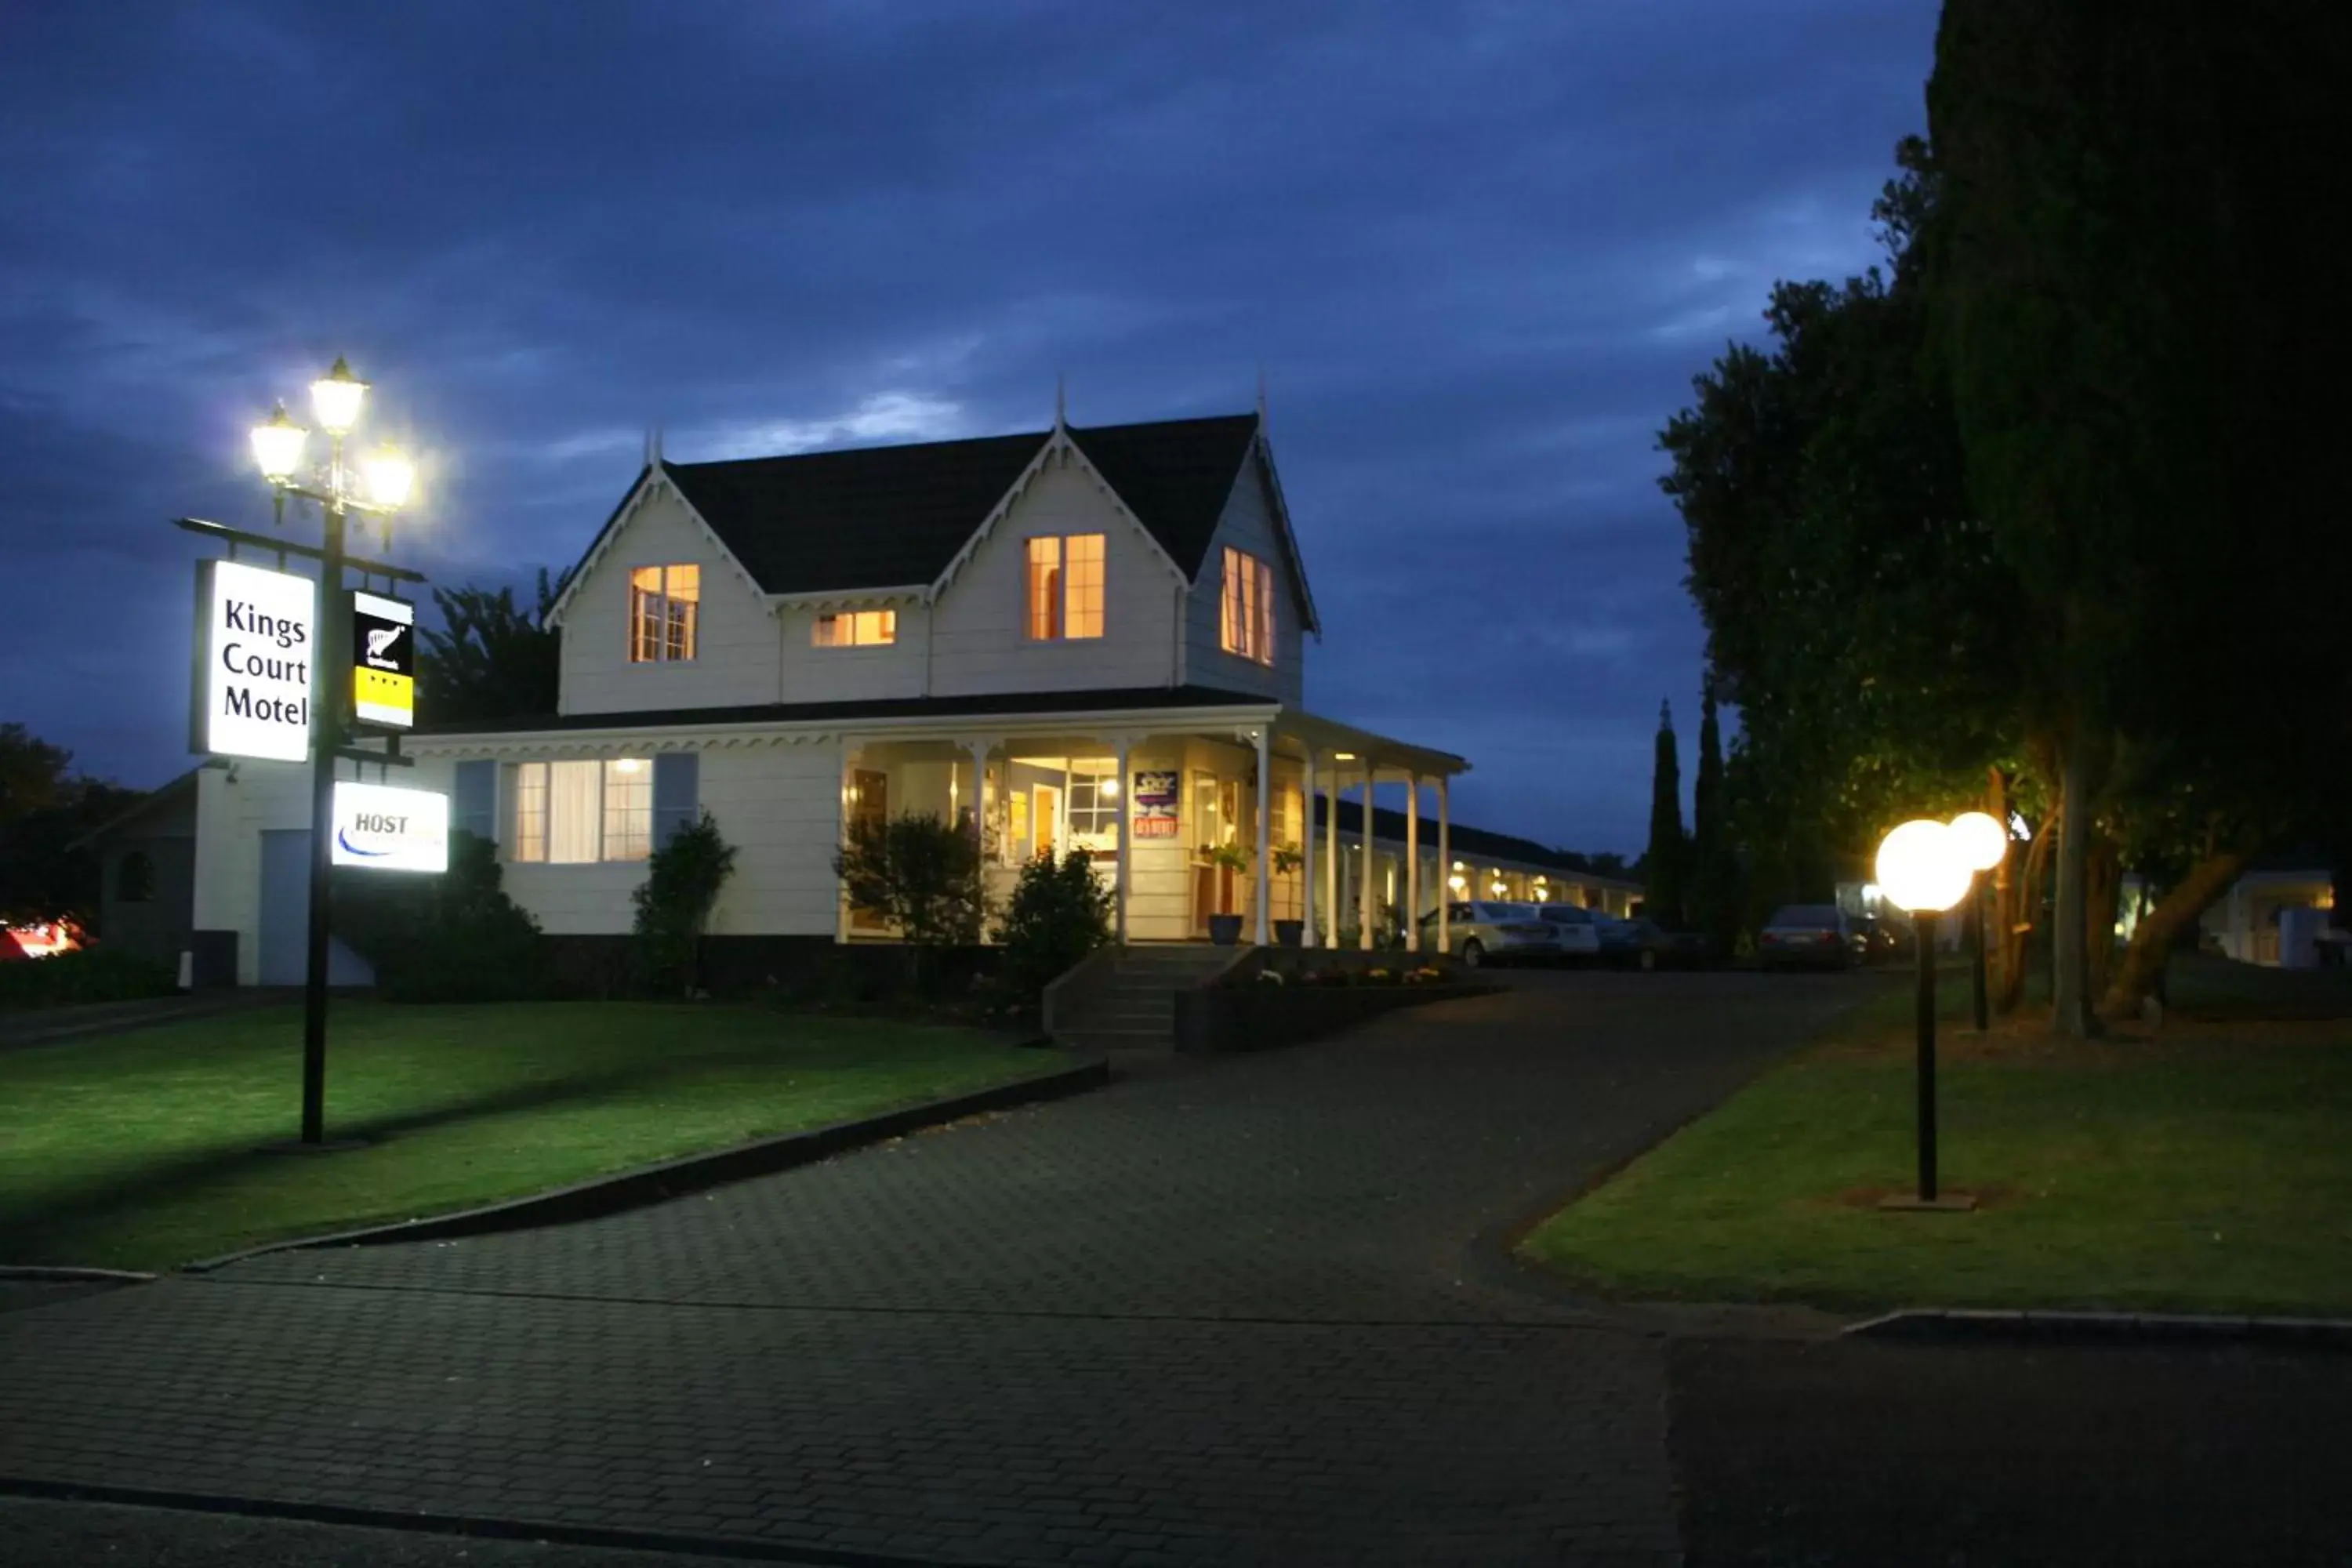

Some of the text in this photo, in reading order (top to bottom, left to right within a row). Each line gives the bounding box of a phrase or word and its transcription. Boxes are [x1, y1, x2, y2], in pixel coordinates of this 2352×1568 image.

[226, 599, 306, 649] Kings
[223, 642, 307, 686] Court
[224, 685, 308, 725] Motel
[354, 812, 409, 834] HOST
